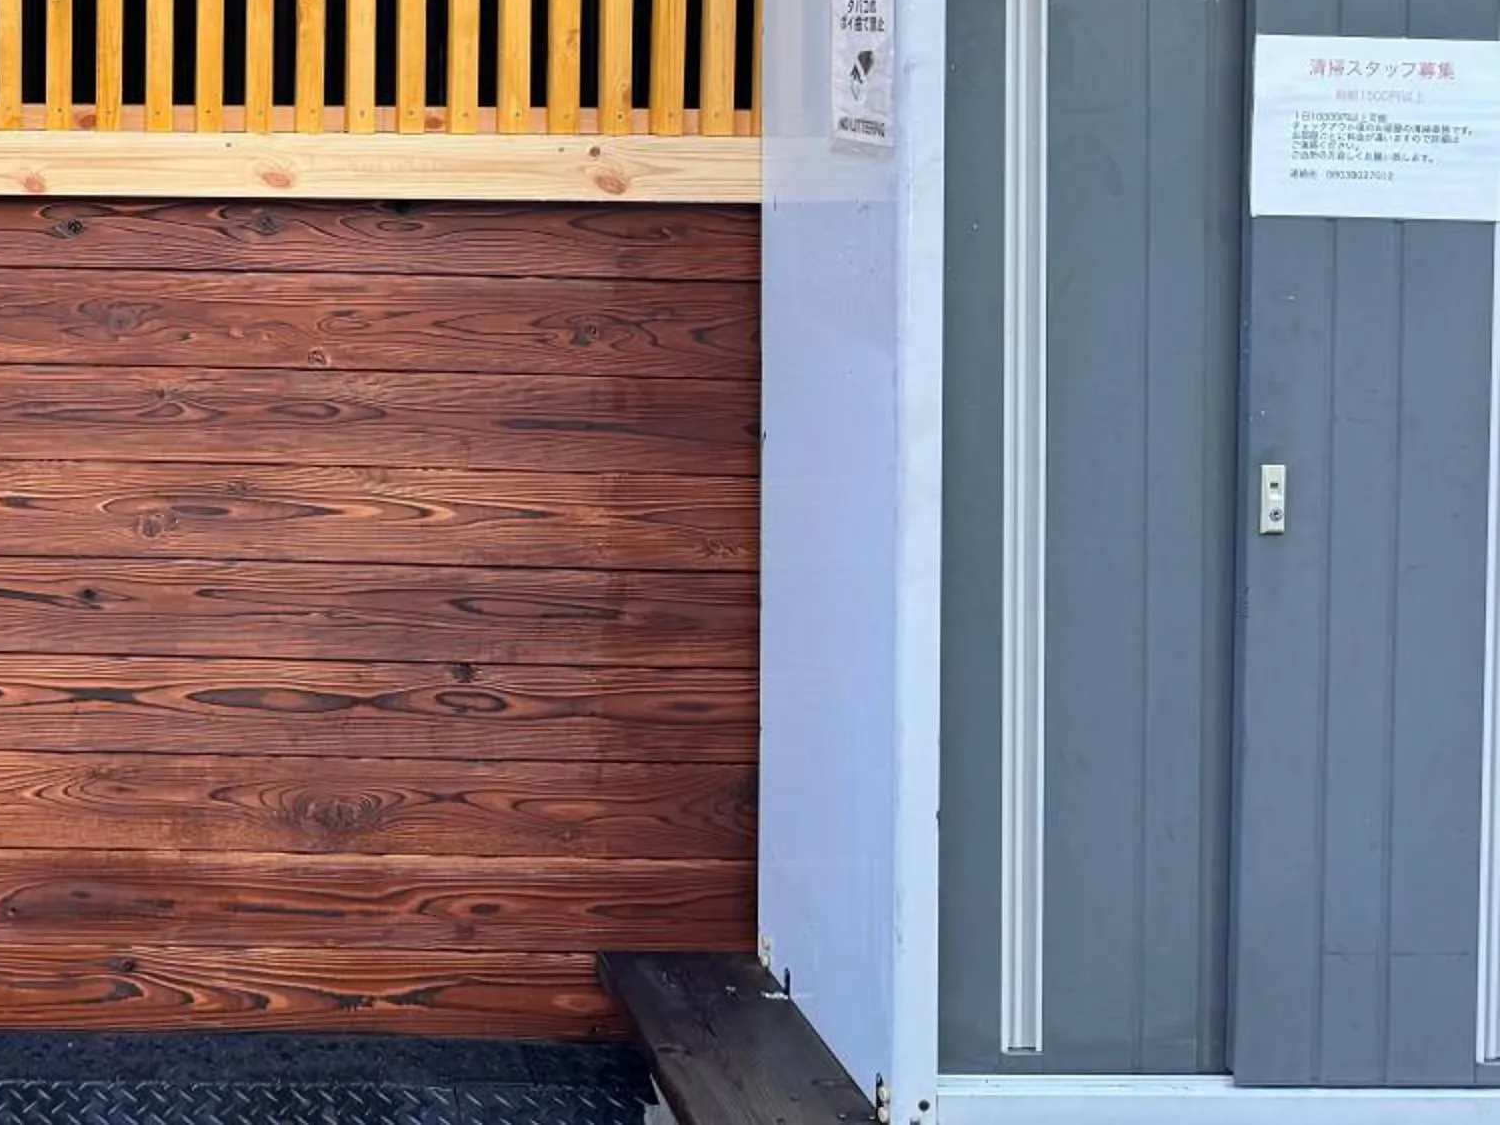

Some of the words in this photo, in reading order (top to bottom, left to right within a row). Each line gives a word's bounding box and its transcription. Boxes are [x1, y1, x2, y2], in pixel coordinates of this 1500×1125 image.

[1309, 58, 1456, 81] 清掃スタッフ募集
